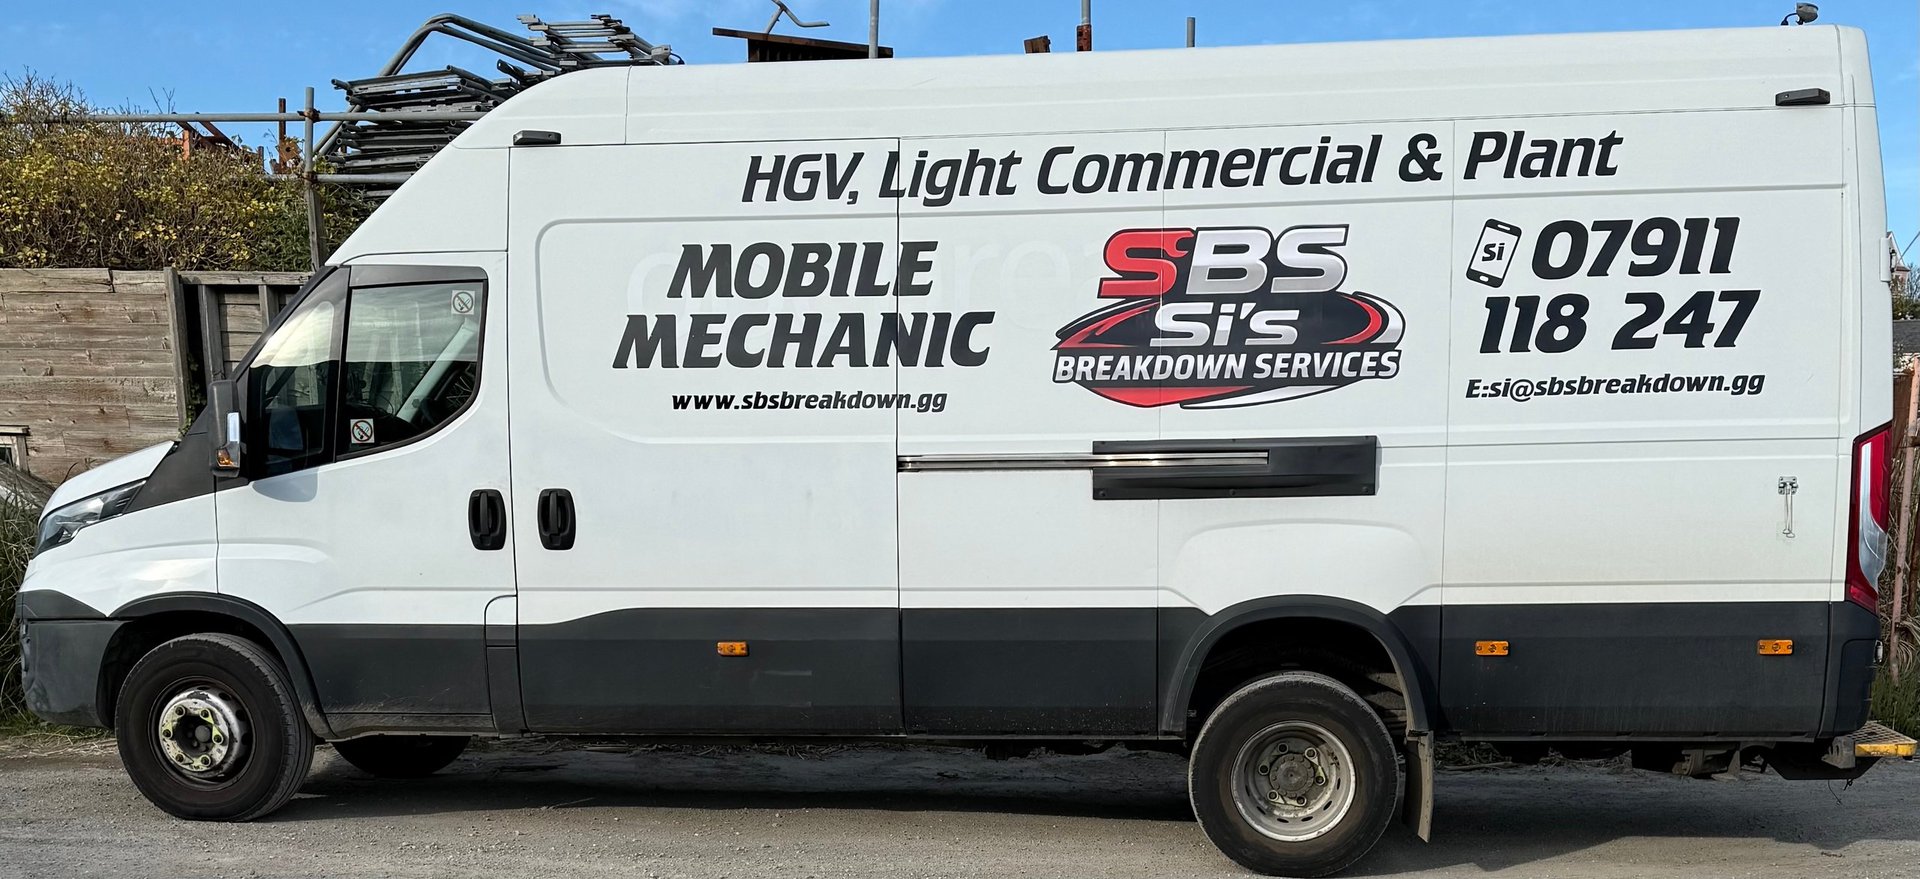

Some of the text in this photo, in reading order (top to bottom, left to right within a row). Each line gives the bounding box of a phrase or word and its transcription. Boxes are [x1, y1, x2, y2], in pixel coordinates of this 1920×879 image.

[742, 130, 1624, 207] HGV, Light Commercial & Plant
[667, 241, 938, 299] MOBILE
[1100, 226, 1347, 297] SBS
[1482, 242, 1505, 262] Si
[1532, 217, 1740, 280] 07911
[613, 311, 995, 369] MECHANIC
[1150, 302, 1300, 347] Si's
[1480, 290, 1761, 354] 118 247
[1055, 351, 1399, 381] BREAKDOWN SERVICES
[1466, 373, 1765, 402] E:si@sbsbreakdown.gg
[672, 391, 947, 412] www.sbsbreakdown.gg
